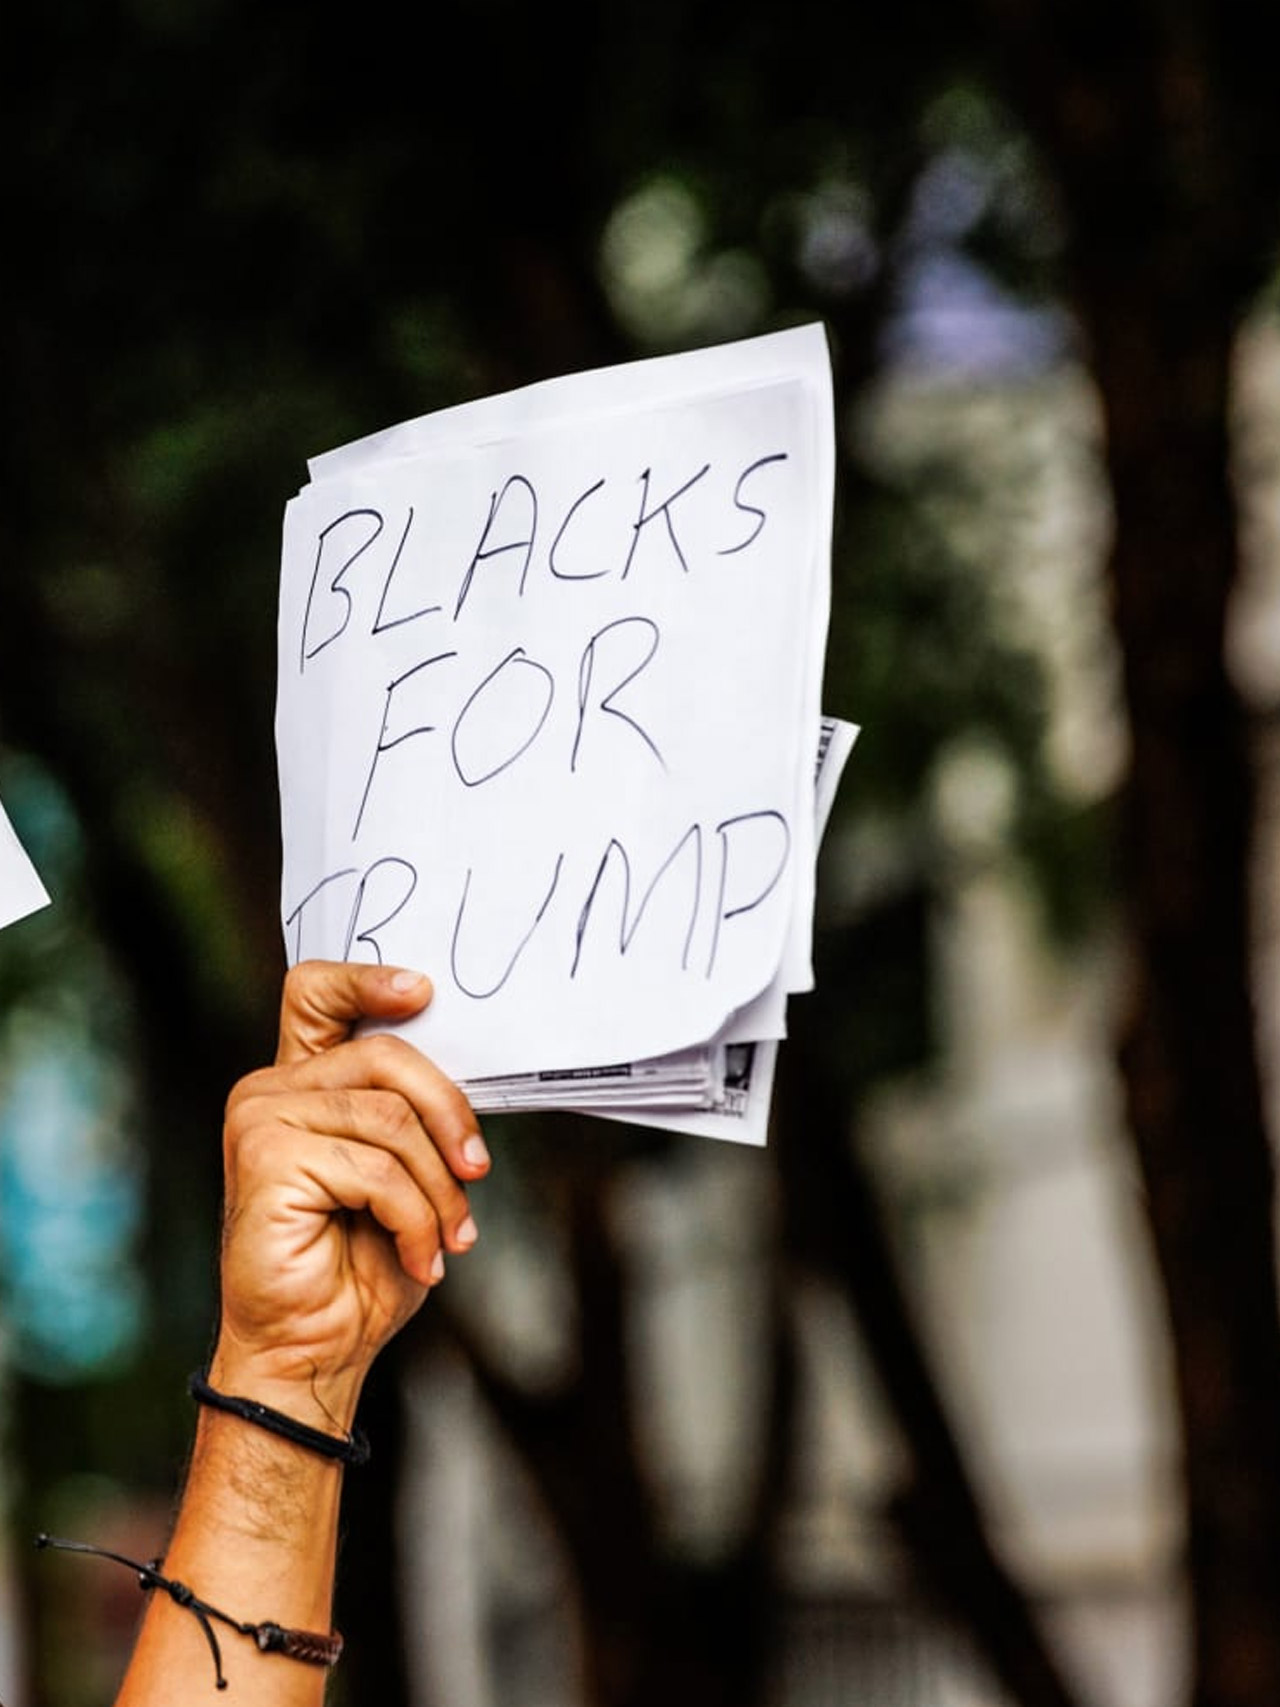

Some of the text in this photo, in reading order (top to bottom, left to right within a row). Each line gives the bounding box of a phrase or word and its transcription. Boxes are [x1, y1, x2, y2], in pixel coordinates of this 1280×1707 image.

[300, 452, 787, 674] BLACKS
[352, 616, 668, 841] FOR
[286, 810, 790, 998] TRUMP
